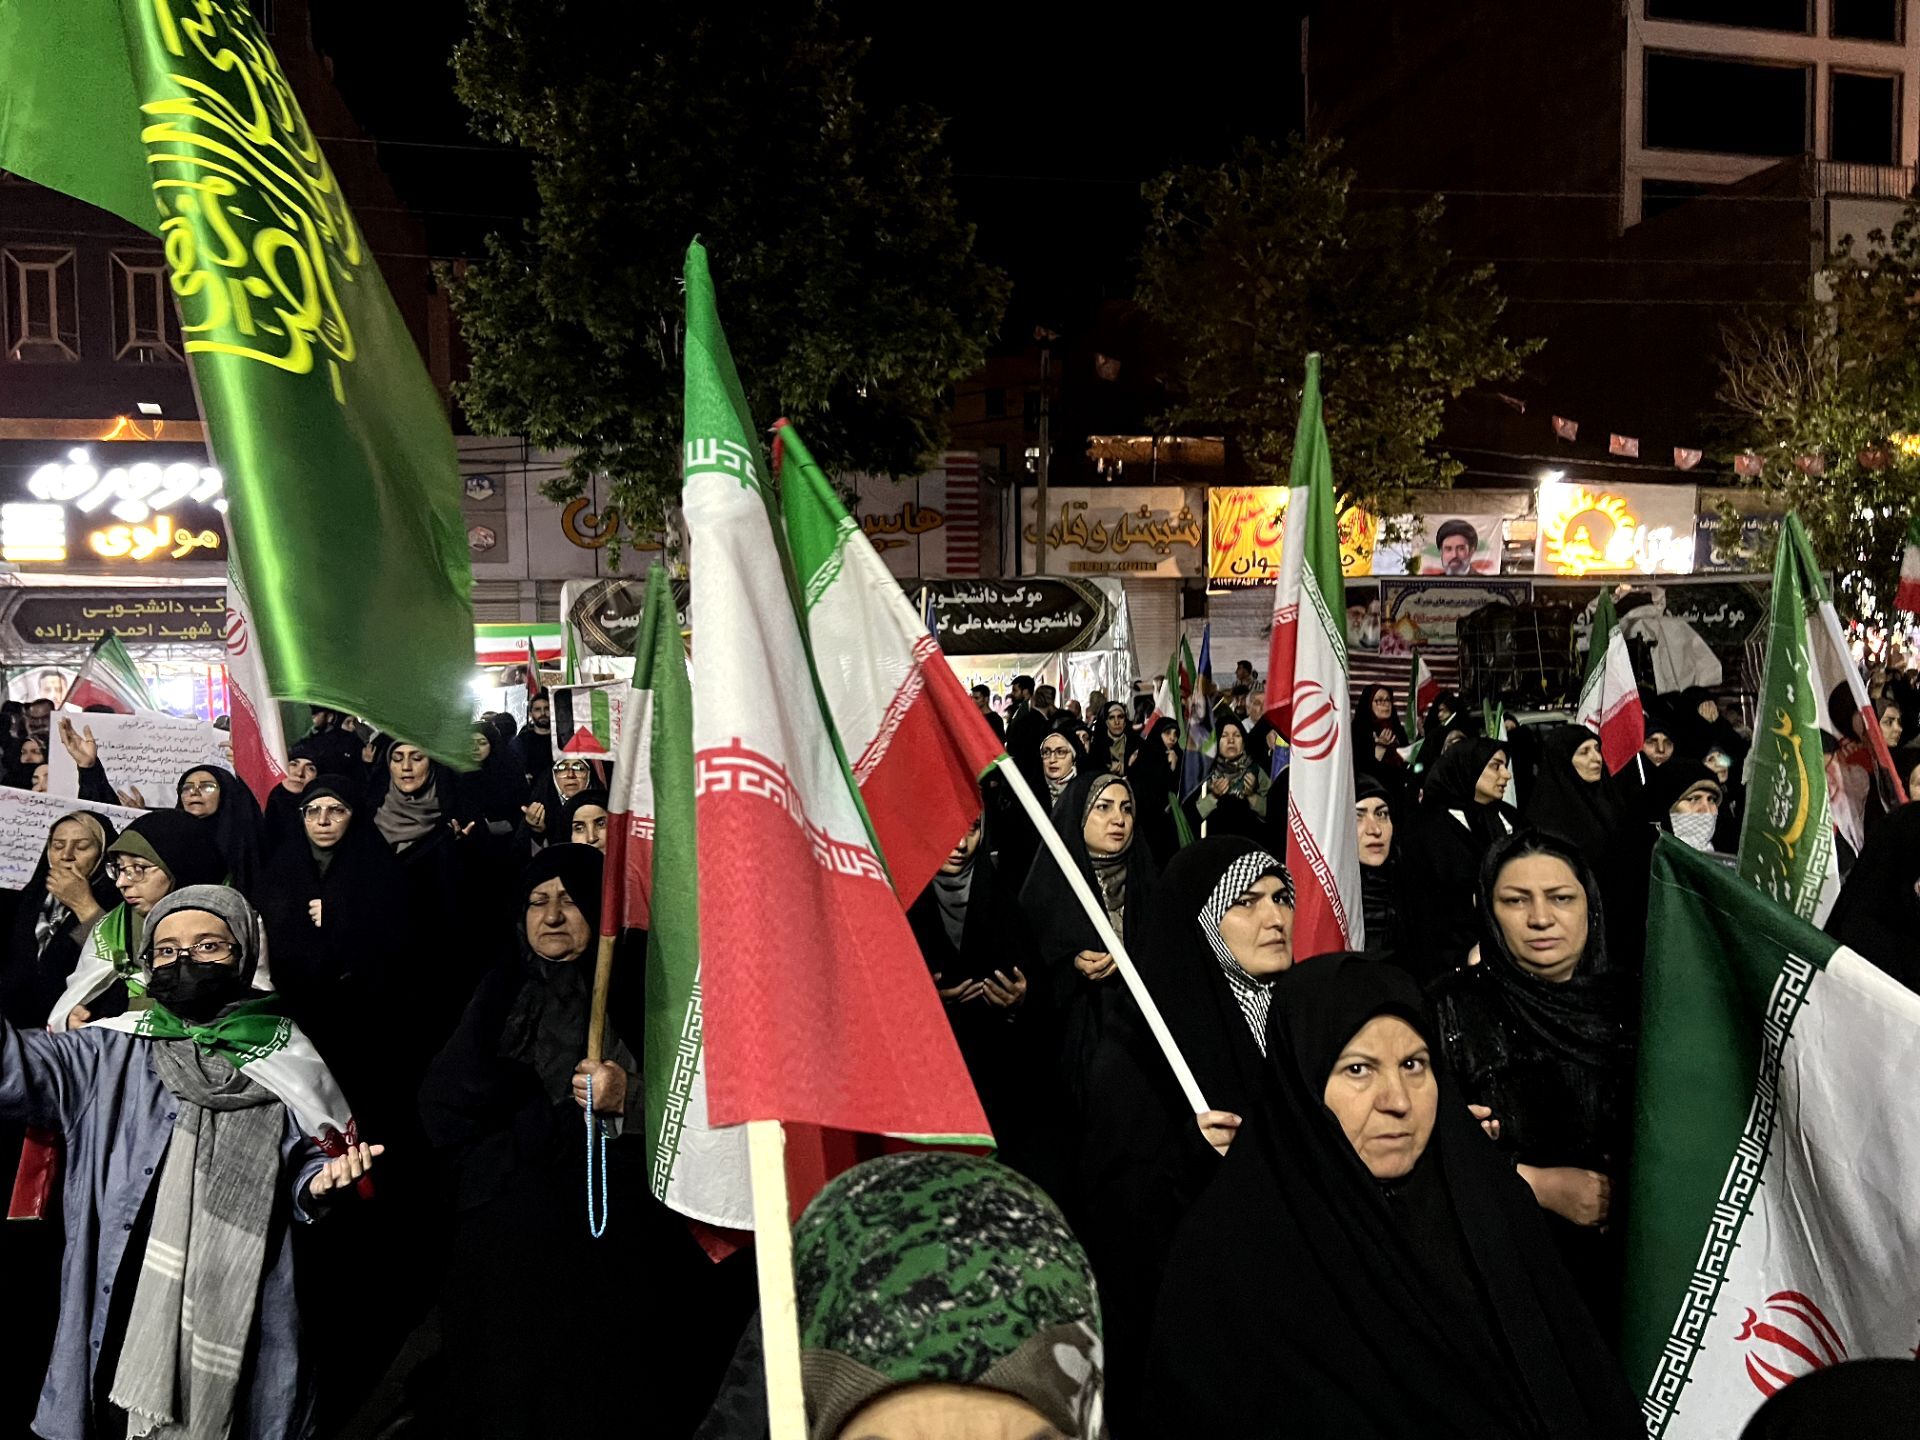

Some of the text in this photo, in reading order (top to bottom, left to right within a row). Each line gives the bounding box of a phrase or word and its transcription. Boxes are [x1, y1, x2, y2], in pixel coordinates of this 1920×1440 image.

[90, 515, 219, 561] مولوی
[1111, 504, 1201, 554] شیشه
[82, 598, 227, 618] کب دانشجویی
[1001, 586, 1043, 608] موکب
[952, 614, 982, 635] علی
[983, 612, 1017, 635] شهید
[1019, 611, 1082, 634] دانشجوی
[1703, 603, 1746, 628] موکب
[112, 623, 152, 638] احمد
[159, 621, 212, 640] شهید
